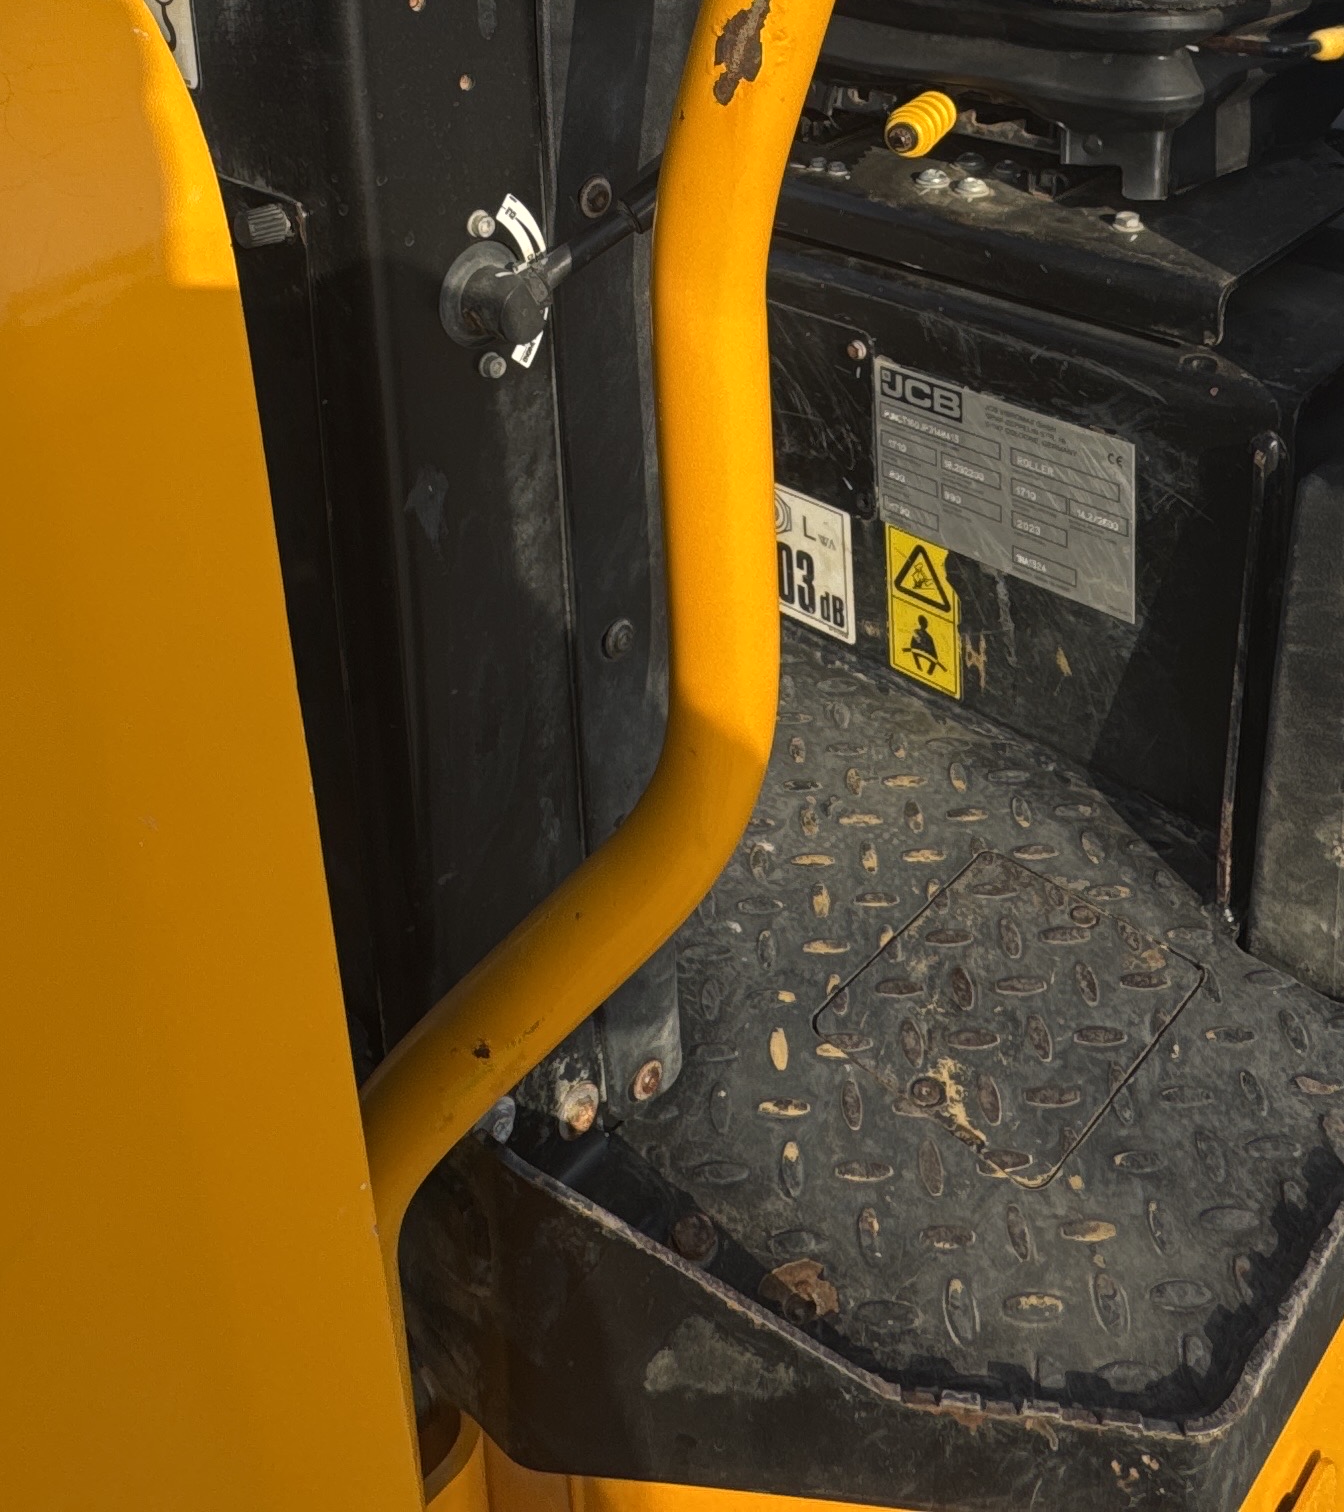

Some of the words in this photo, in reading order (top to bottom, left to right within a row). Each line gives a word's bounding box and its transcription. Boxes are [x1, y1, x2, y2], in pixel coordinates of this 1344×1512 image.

[881, 369, 961, 419] JCB
[1016, 455, 1055, 476] ROLLER
[777, 540, 816, 615] 03
[819, 591, 845, 629] dB
